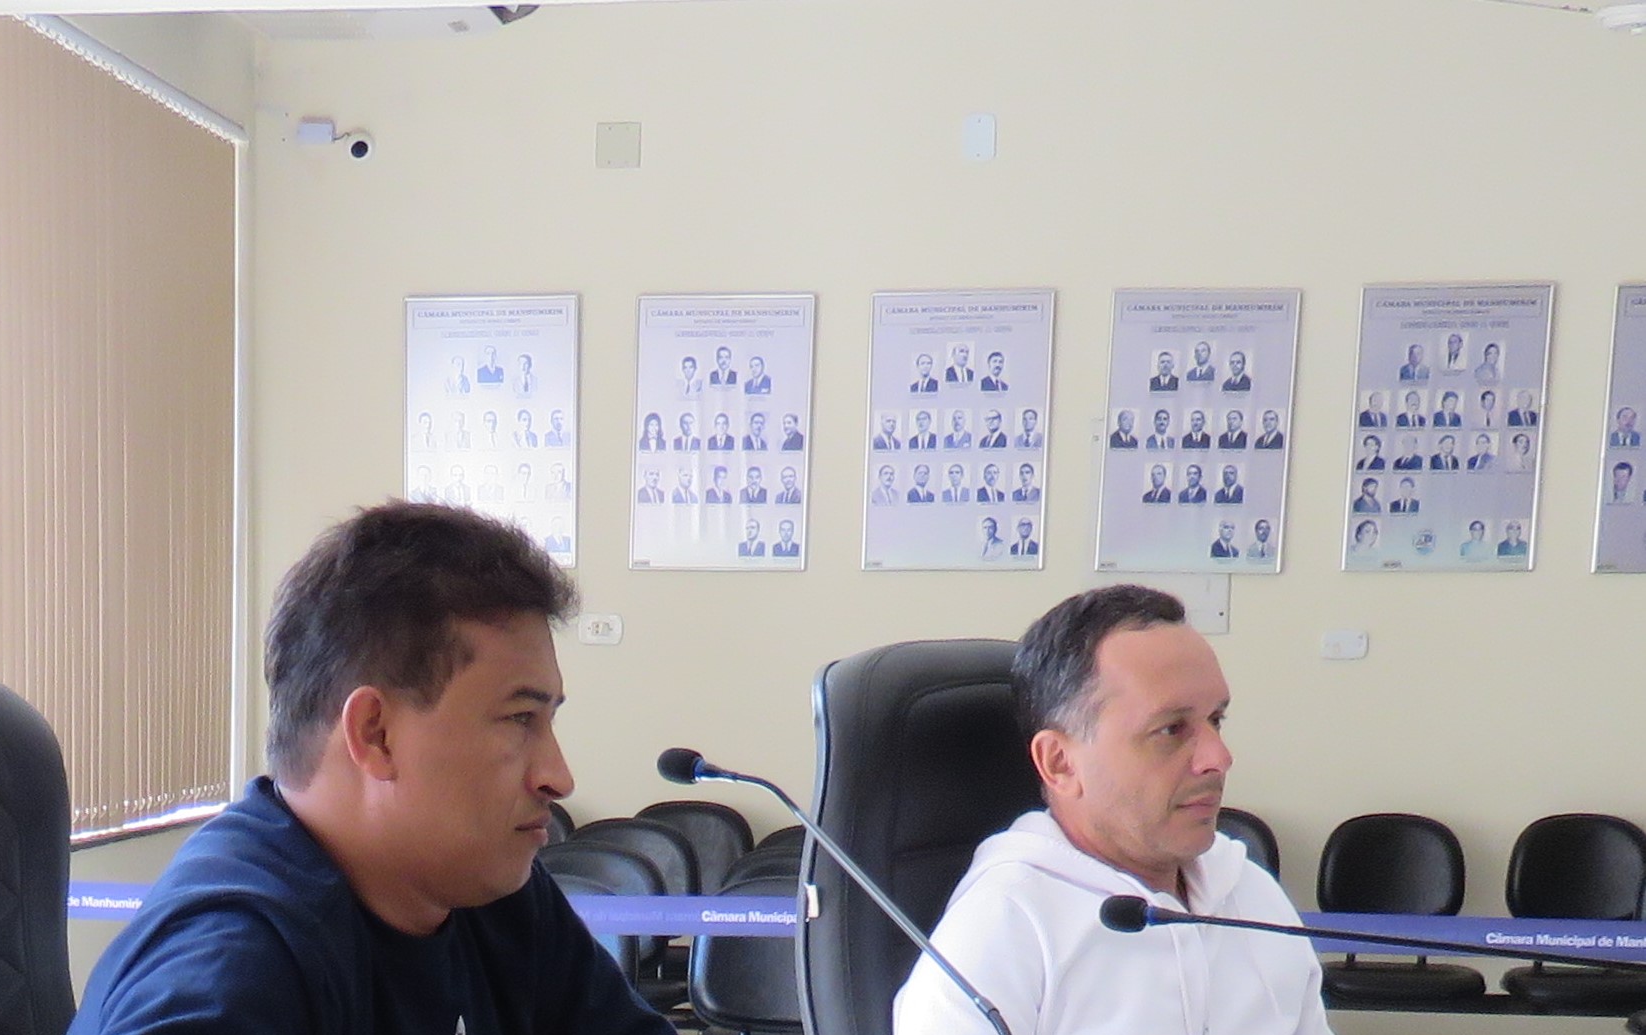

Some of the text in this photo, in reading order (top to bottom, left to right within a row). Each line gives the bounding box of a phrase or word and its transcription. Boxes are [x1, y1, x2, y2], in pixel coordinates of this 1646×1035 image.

[81, 896, 143, 909] Manhumiri
[701, 910, 746, 922] Câmara
[748, 911, 797, 925] Municipa
[1486, 932, 1533, 945] Câmara
[1536, 934, 1595, 948] Municipal
[1597, 935, 1613, 947] de
